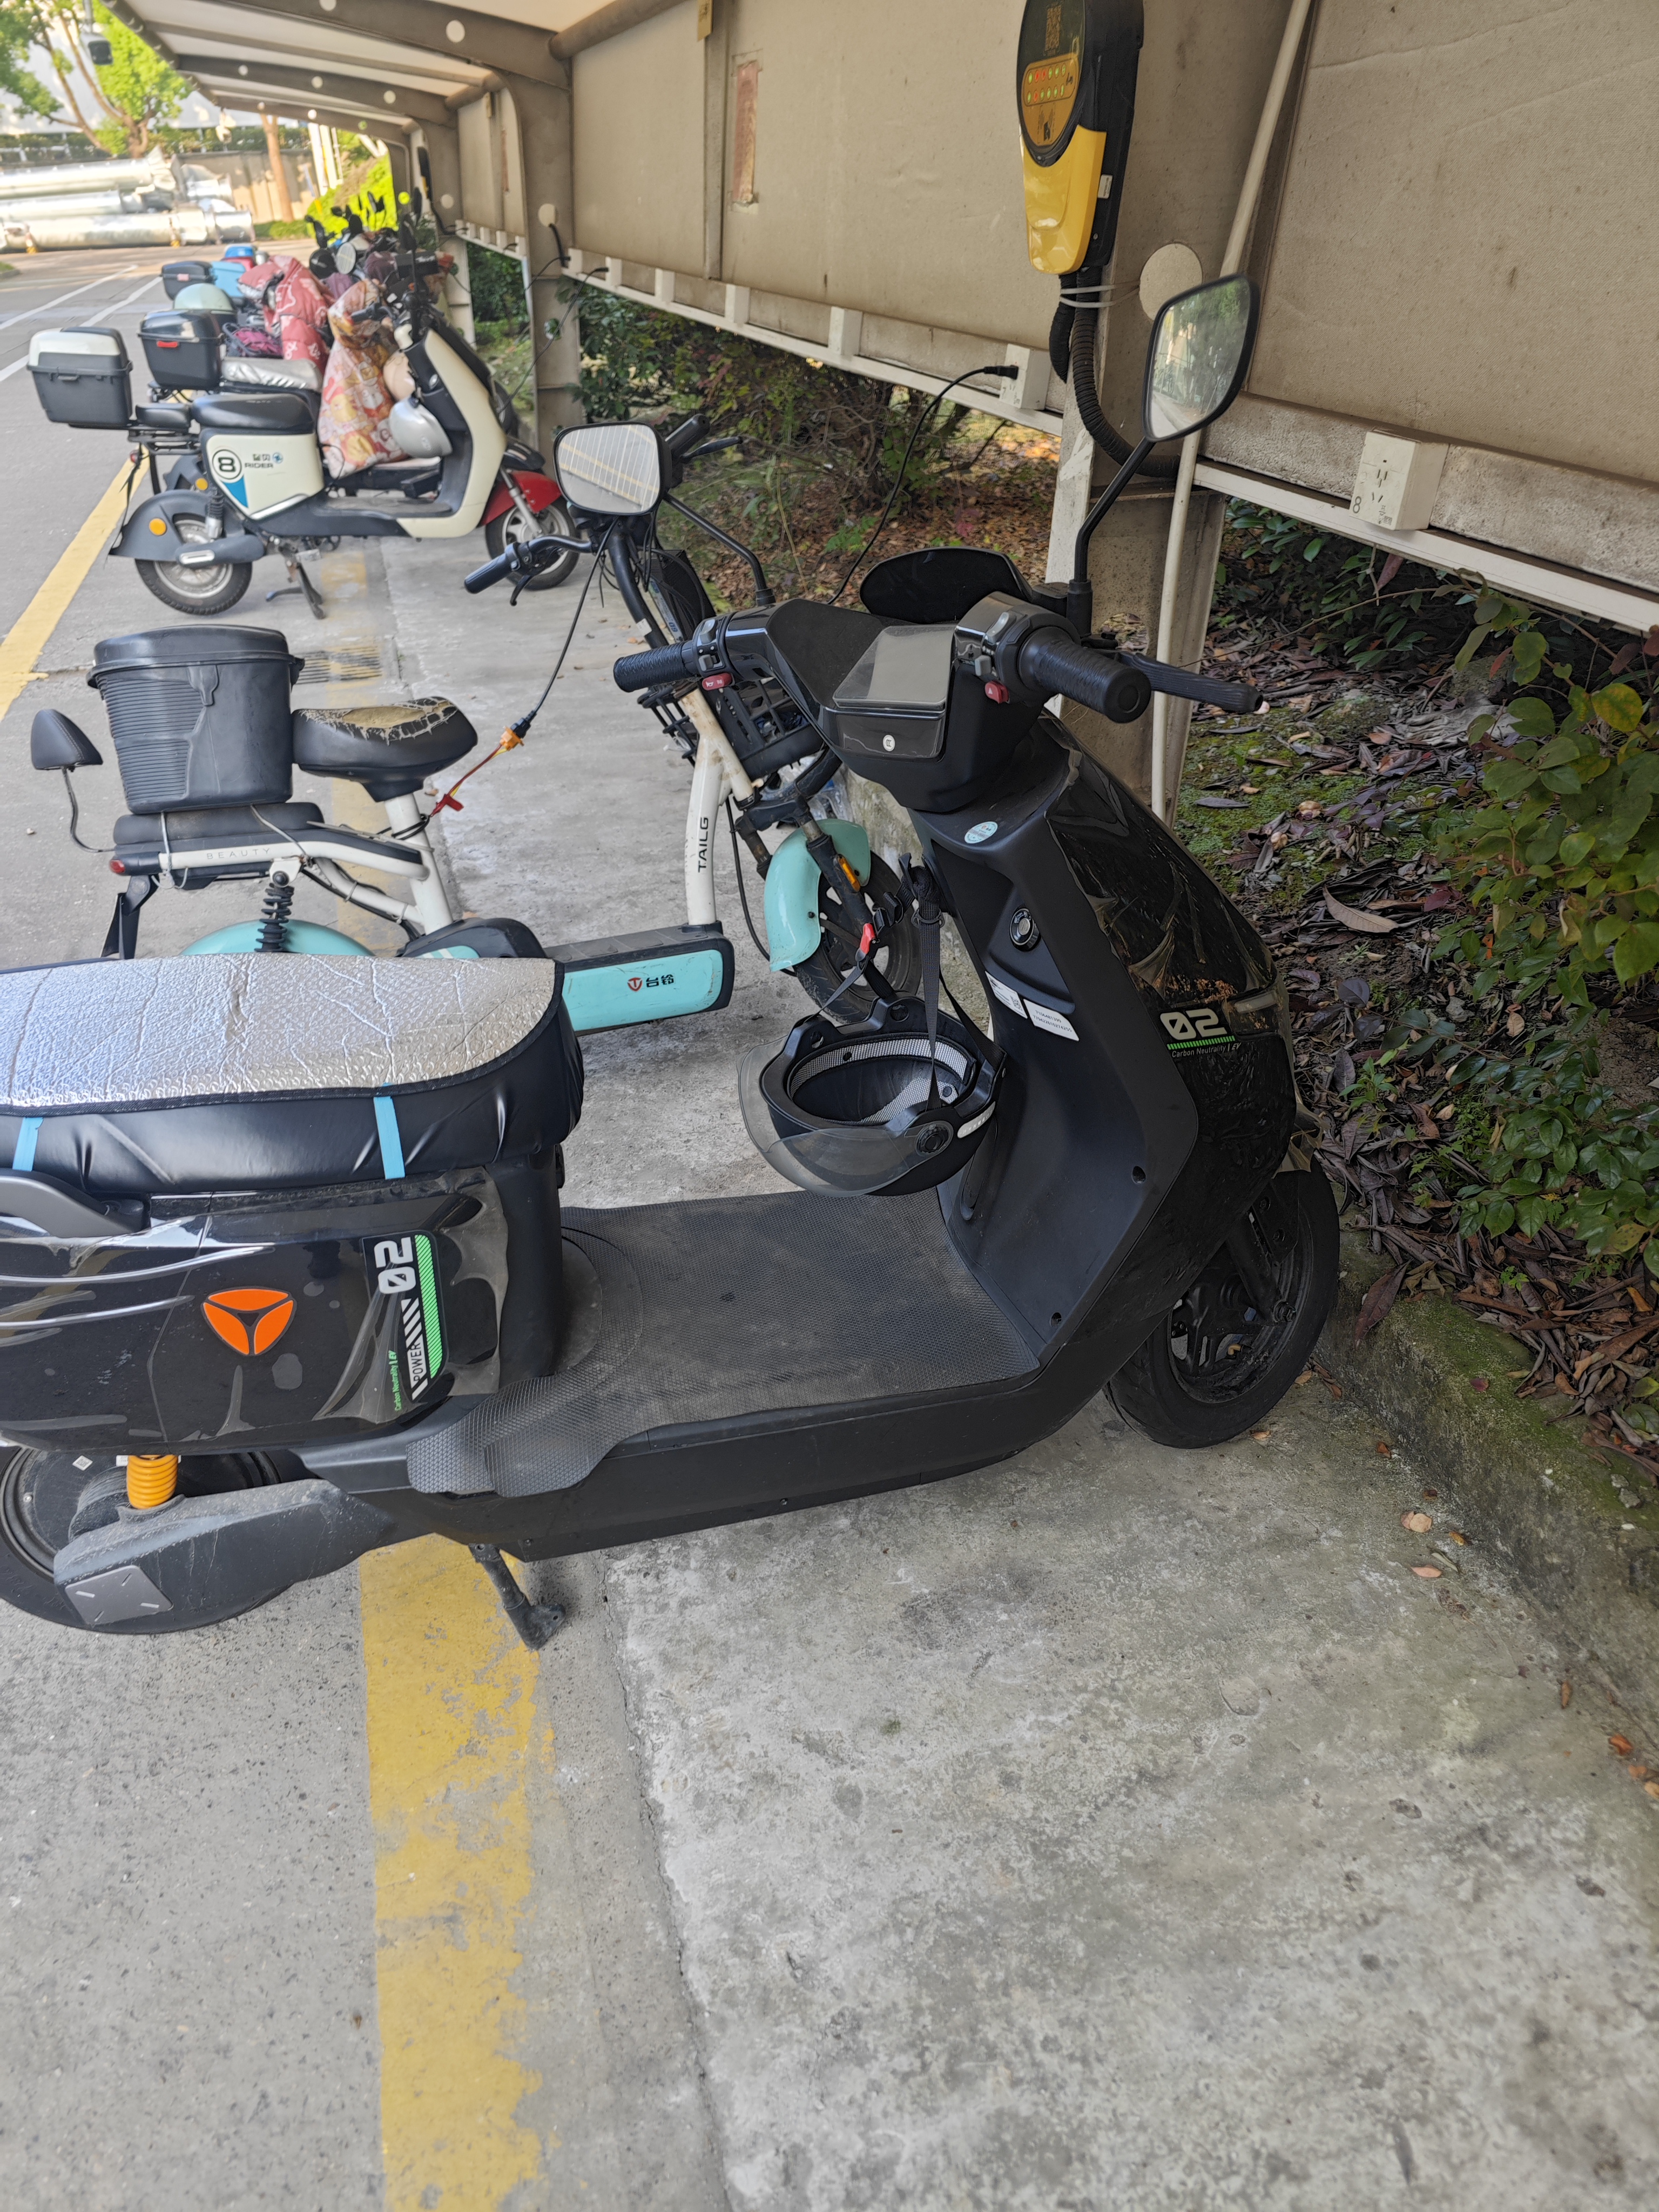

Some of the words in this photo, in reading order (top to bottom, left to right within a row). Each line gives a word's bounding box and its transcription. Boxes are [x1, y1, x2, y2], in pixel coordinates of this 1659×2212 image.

[218, 456, 237, 473] 8
[1353, 496, 1361, 514] 8
[206, 847, 269, 860] BEAUTY
[698, 817, 709, 873] TAILG
[646, 974, 674, 988] 台铃
[1160, 1008, 1228, 1040] 02
[1172, 1049, 1195, 1057] Carbon
[1196, 1045, 1226, 1055] Neutrality
[1231, 1042, 1242, 1050] EV
[374, 1236, 416, 1294] 02
[388, 1350, 397, 1360] EV
[410, 1342, 423, 1382] POWER
[390, 1365, 400, 1392] Neutrality
